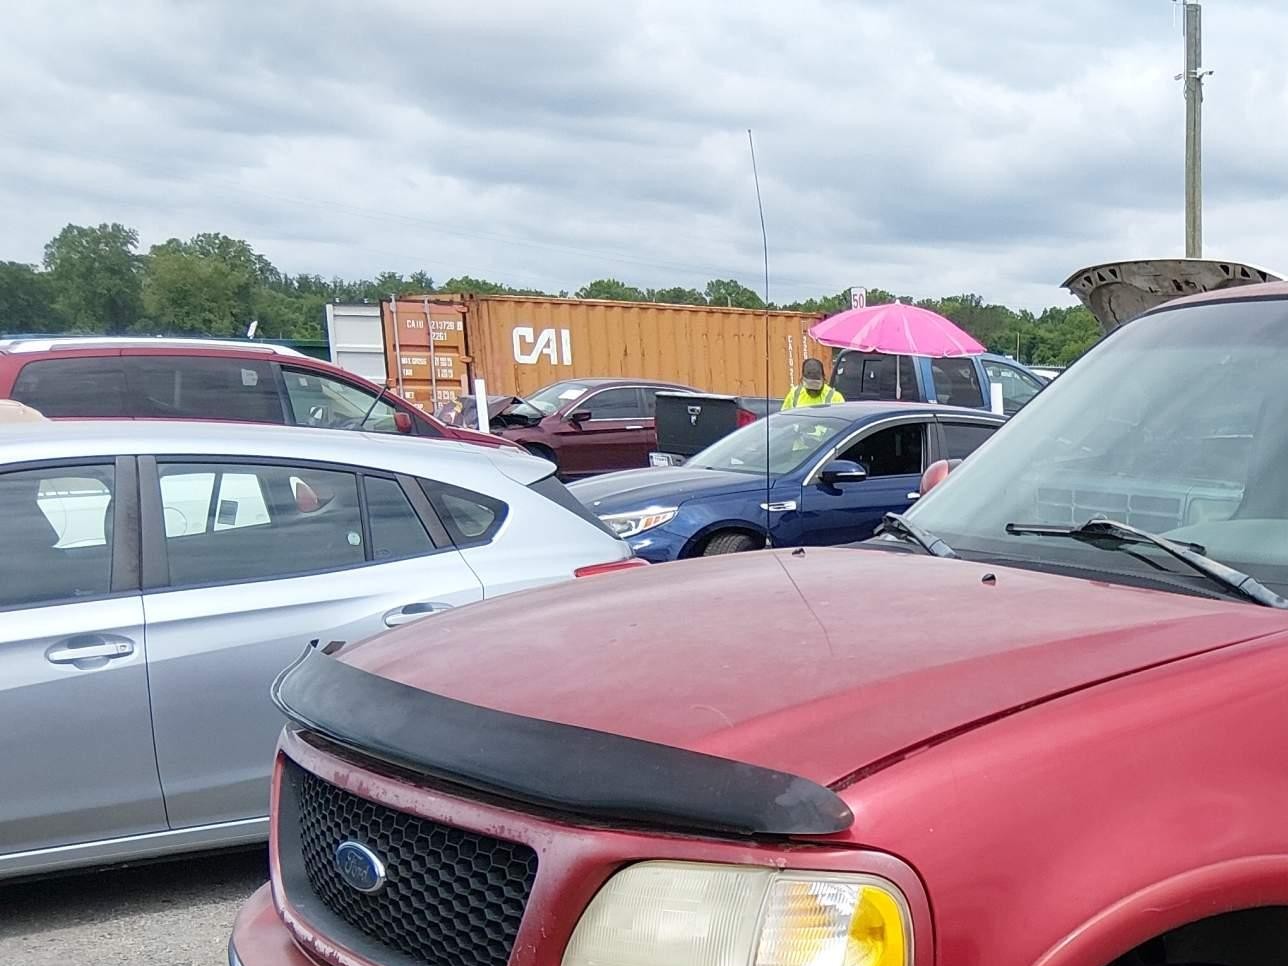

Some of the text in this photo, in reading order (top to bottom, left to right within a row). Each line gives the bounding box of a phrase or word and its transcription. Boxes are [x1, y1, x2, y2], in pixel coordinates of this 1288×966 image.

[852, 293, 864, 309] 50
[513, 326, 573, 366] CAI
[344, 850, 369, 881] Ford
